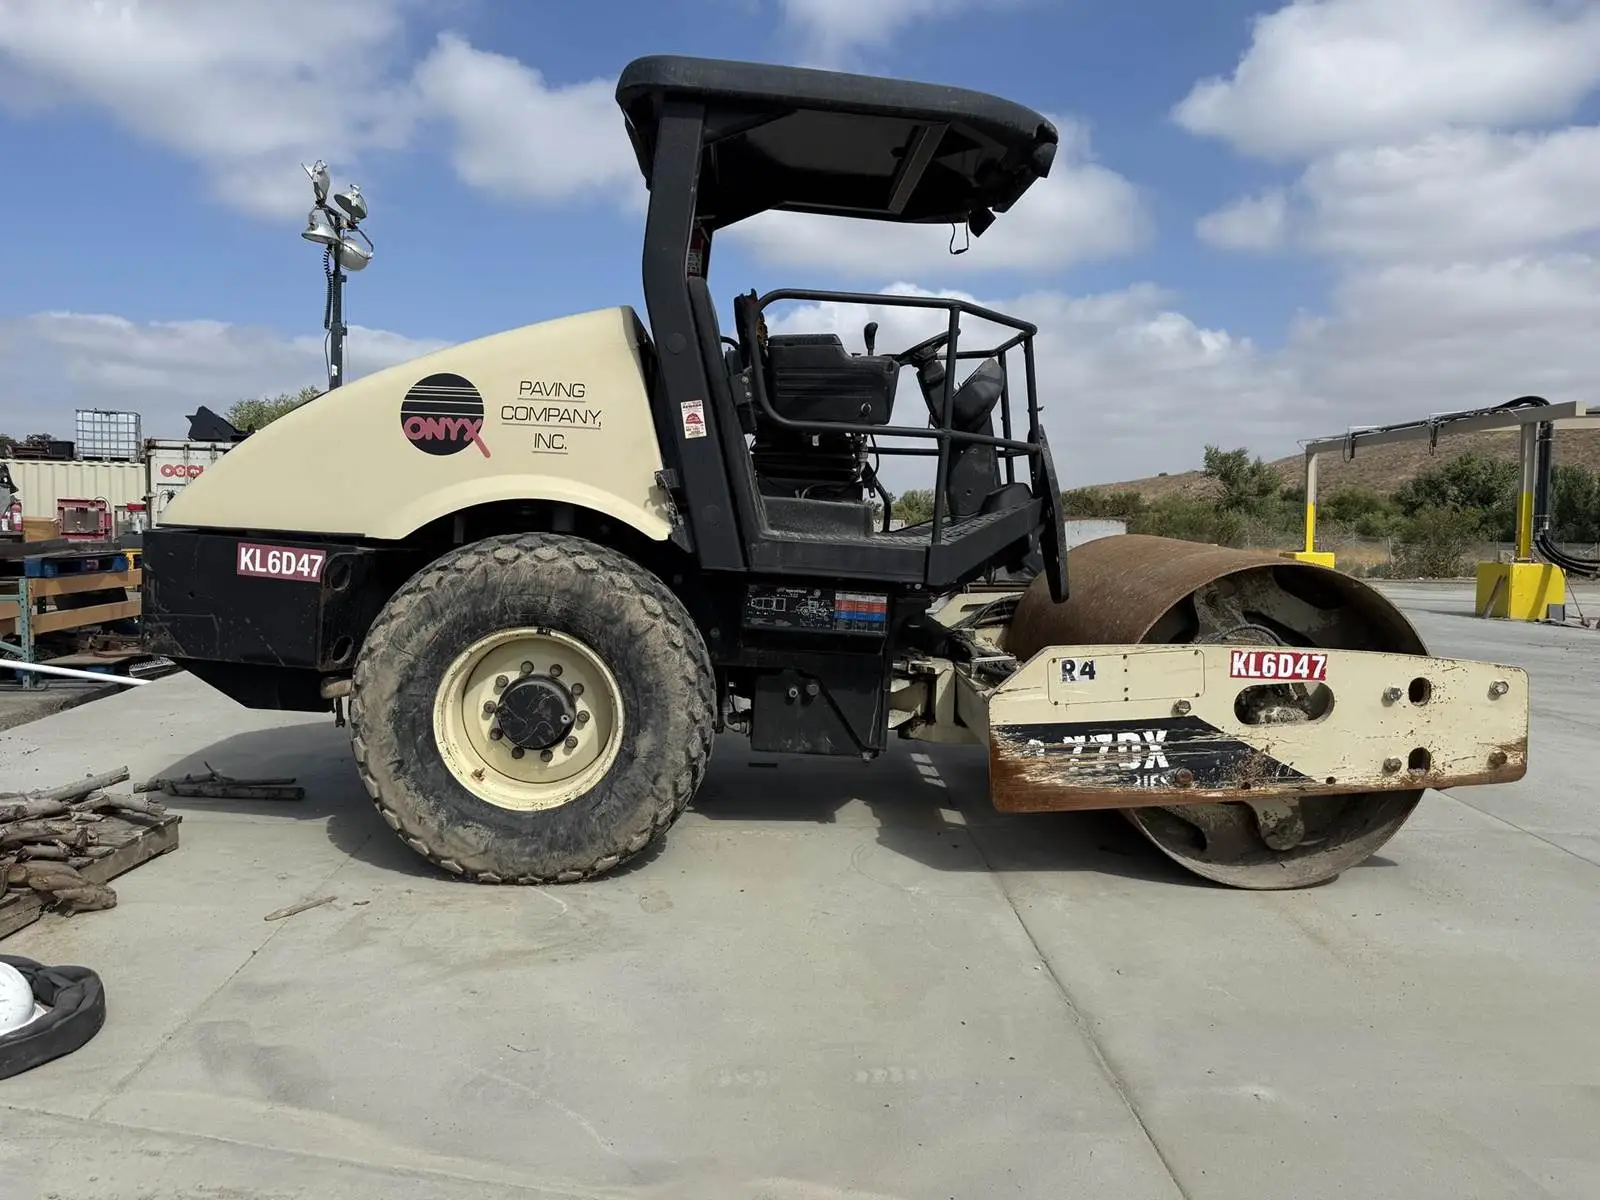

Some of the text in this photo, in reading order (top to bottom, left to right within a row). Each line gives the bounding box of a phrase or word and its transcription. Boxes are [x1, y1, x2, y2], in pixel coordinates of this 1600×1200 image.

[519, 380, 586, 398] PAVING
[501, 405, 602, 428] COMPANY,
[403, 416, 491, 459] ONYX
[533, 433, 567, 450] INC.
[240, 547, 323, 578] KL6D47
[1231, 652, 1326, 679] KL6D47
